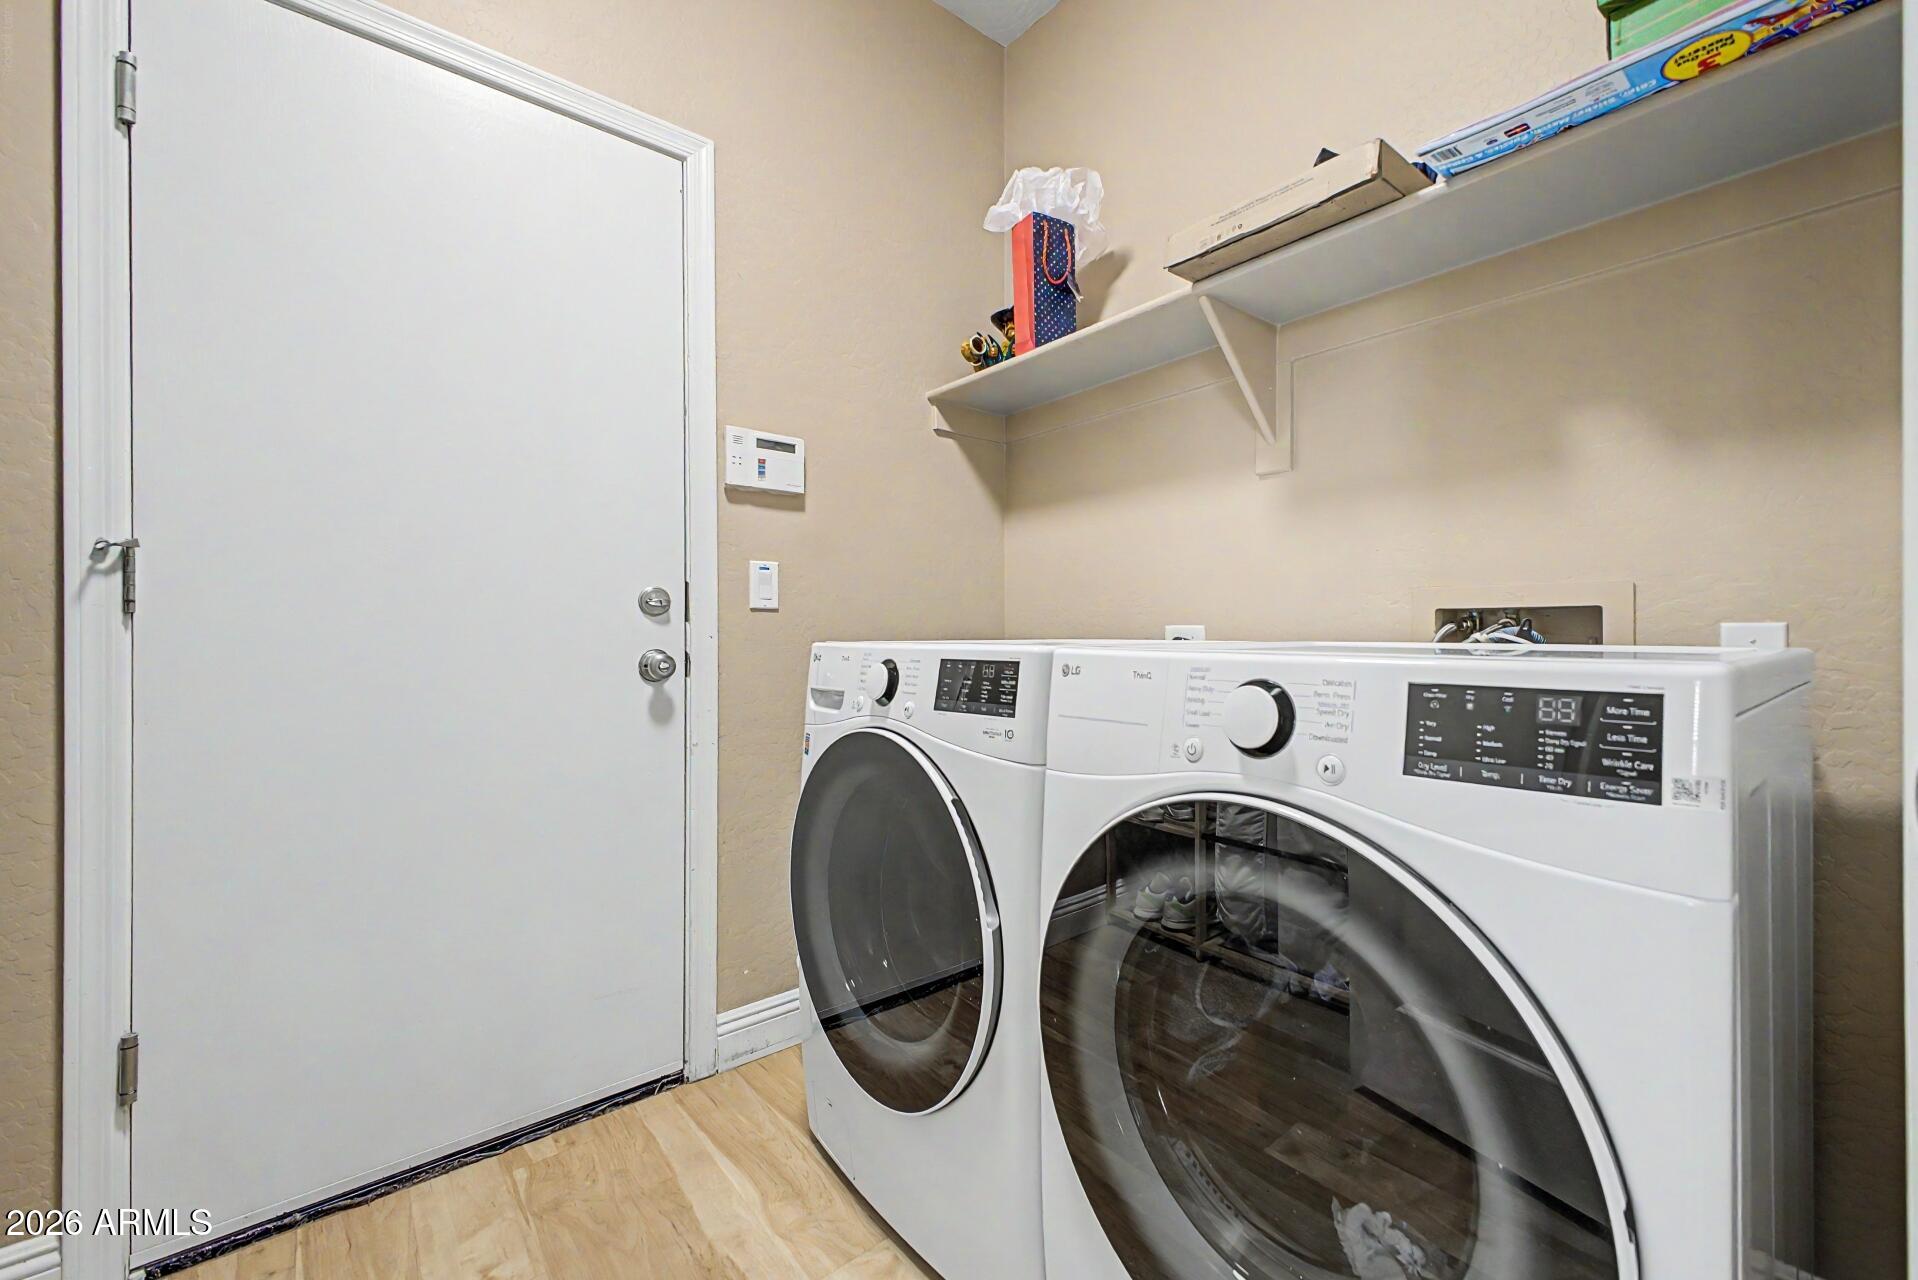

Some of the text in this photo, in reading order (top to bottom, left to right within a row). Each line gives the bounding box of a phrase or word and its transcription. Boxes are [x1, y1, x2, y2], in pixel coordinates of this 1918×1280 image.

[1606, 706, 1651, 717] More Time
[1606, 733, 1648, 744] Less Time
[1601, 758, 1655, 772] Wrinkle Care
[1557, 777, 1573, 788] Dry
